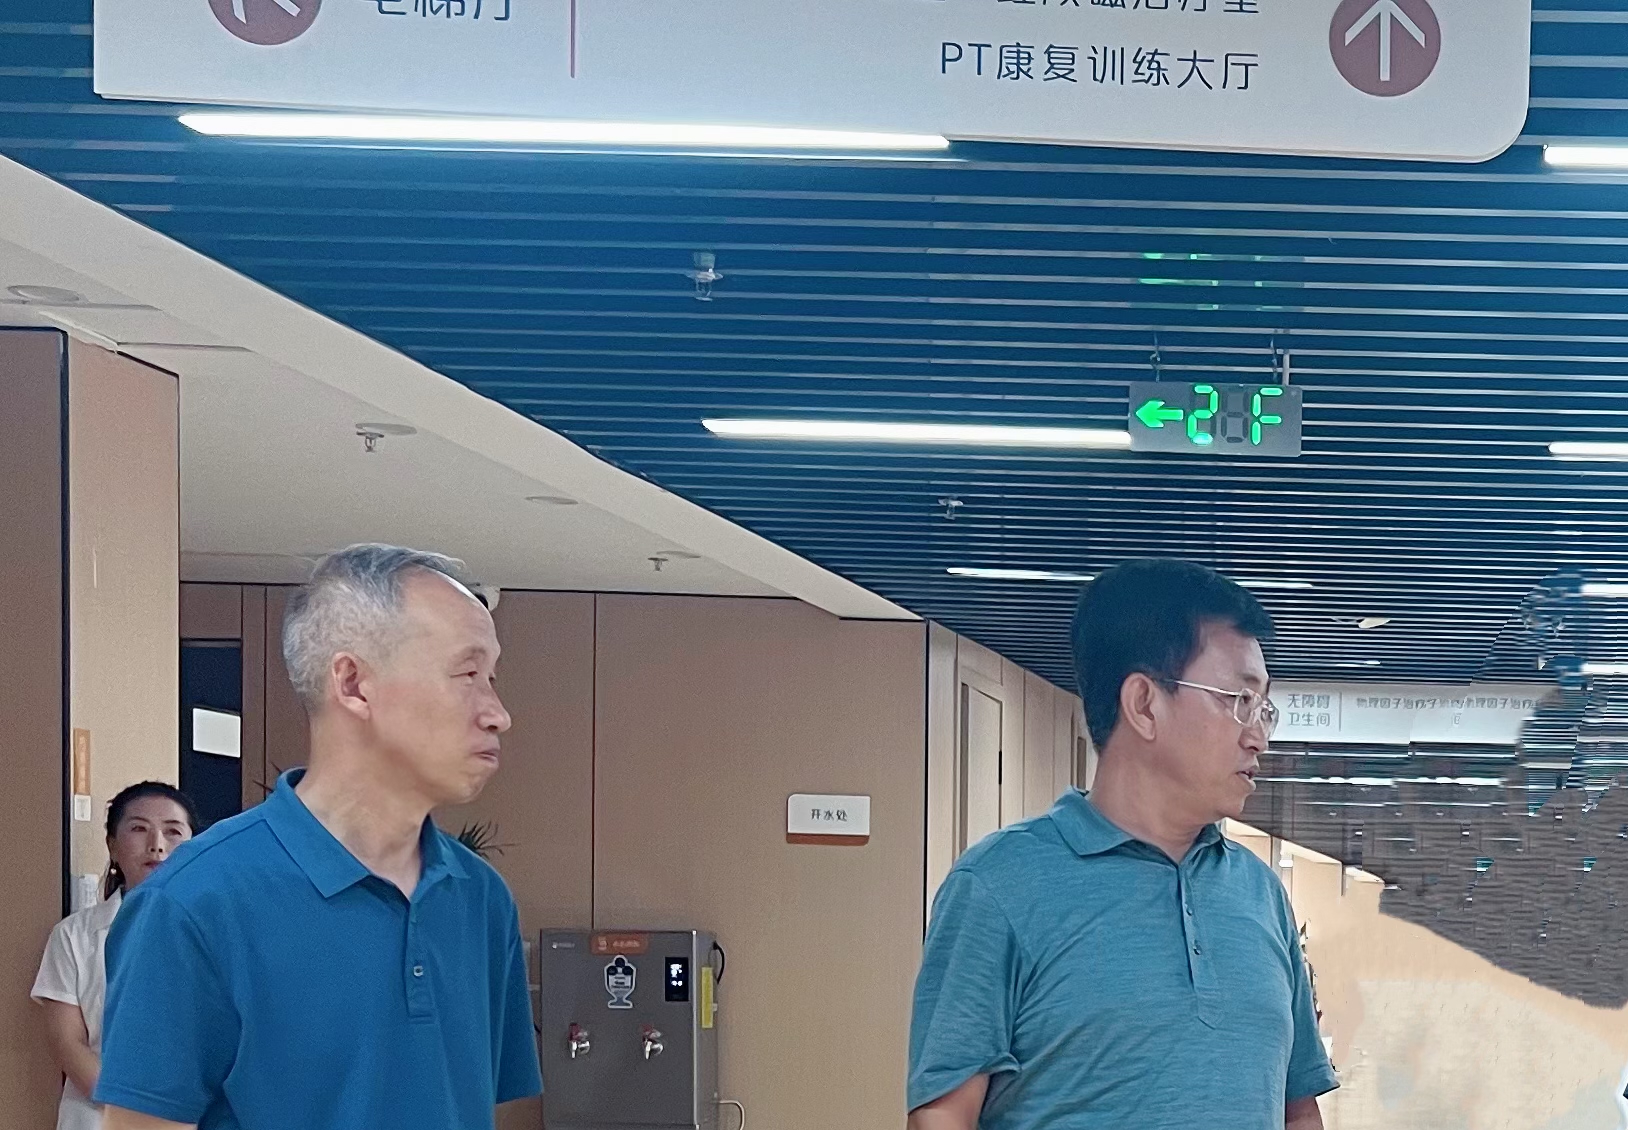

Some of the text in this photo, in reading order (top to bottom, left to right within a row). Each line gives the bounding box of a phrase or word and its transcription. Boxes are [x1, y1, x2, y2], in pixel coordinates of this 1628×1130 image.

[941, 41, 1259, 91] PT康复训练大厅
[1288, 711, 1331, 727] 卫生间
[811, 808, 848, 822] 开水处
